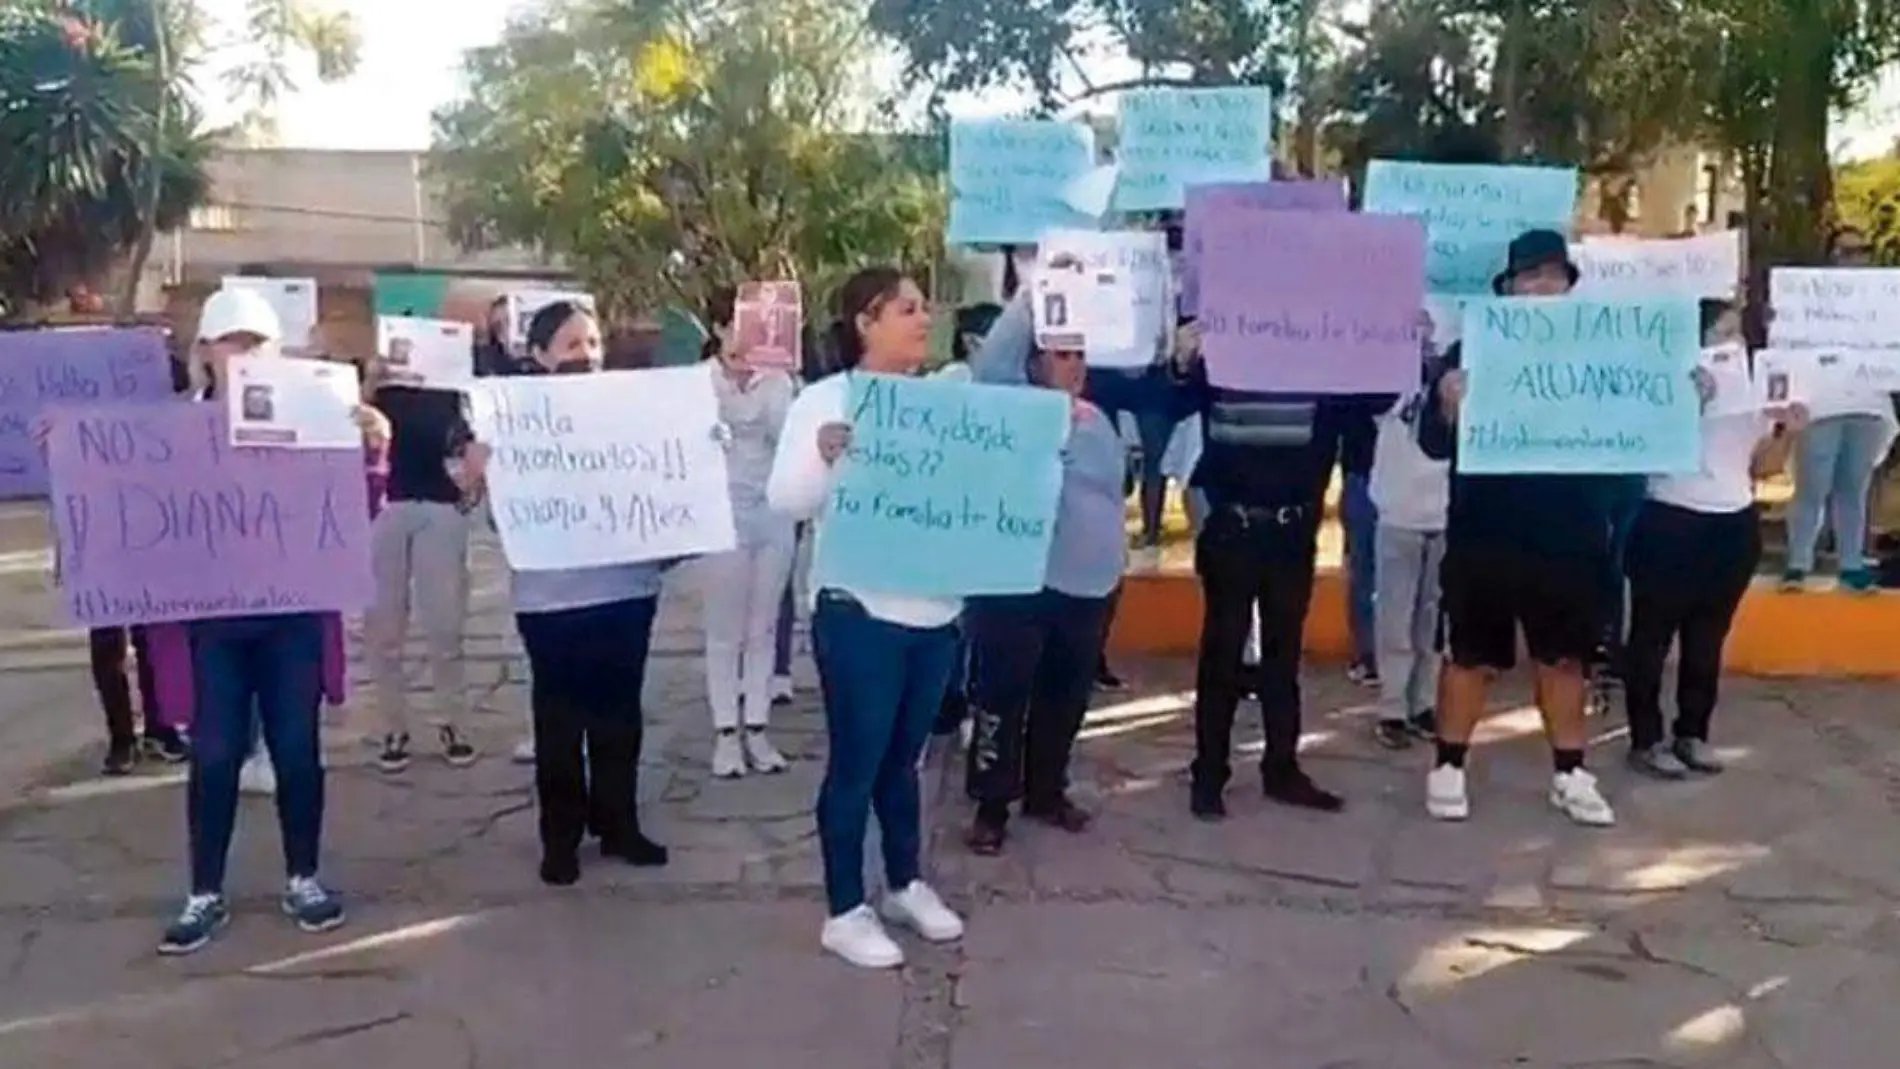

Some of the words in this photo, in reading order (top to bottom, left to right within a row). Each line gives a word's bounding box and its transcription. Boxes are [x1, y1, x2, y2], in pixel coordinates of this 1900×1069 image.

[1486, 305, 1555, 343] NOS
[490, 384, 576, 439] Hasta
[77, 416, 173, 468] NOS
